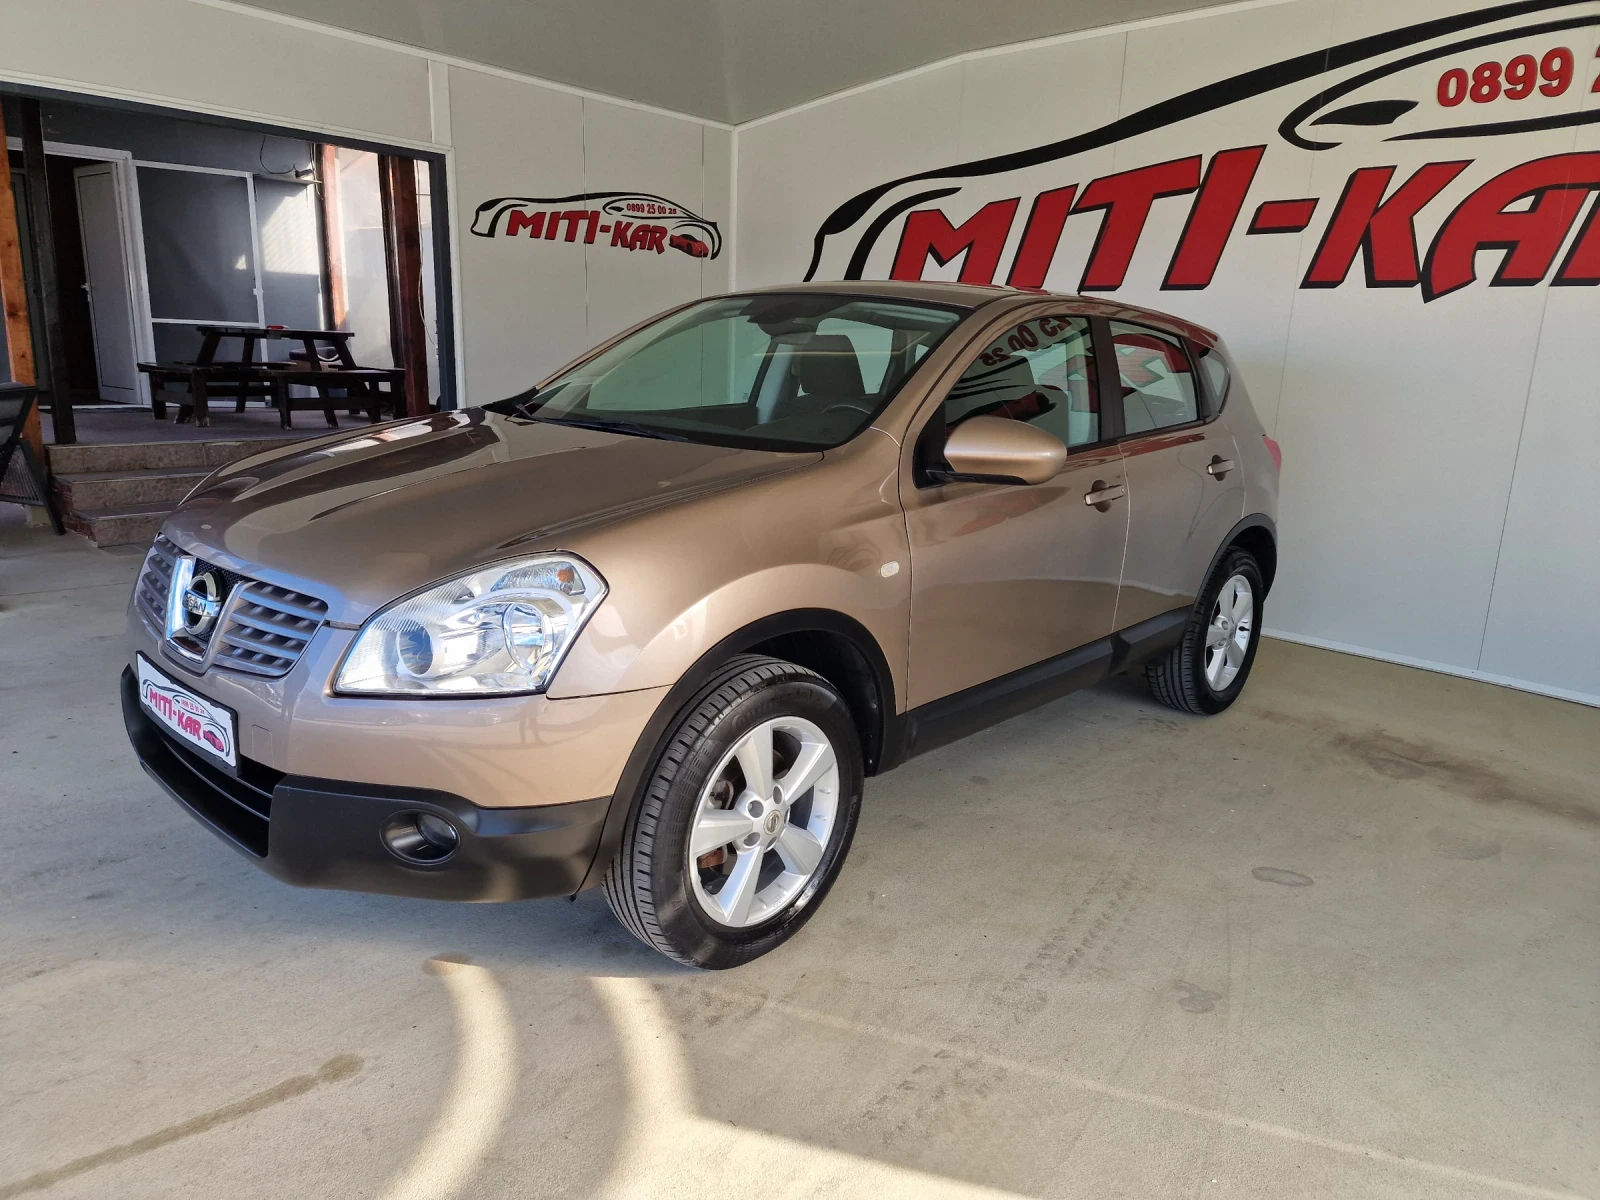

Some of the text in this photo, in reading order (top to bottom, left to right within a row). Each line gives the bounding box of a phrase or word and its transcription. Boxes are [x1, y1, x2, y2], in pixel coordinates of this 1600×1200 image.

[1437, 46, 1575, 108] 0899
[506, 210, 668, 255] MITI-KAR
[626, 203, 645, 213] 0899
[646, 203, 656, 215] 25
[657, 205, 667, 215] 00
[149, 687, 202, 740] MITI-KAR
